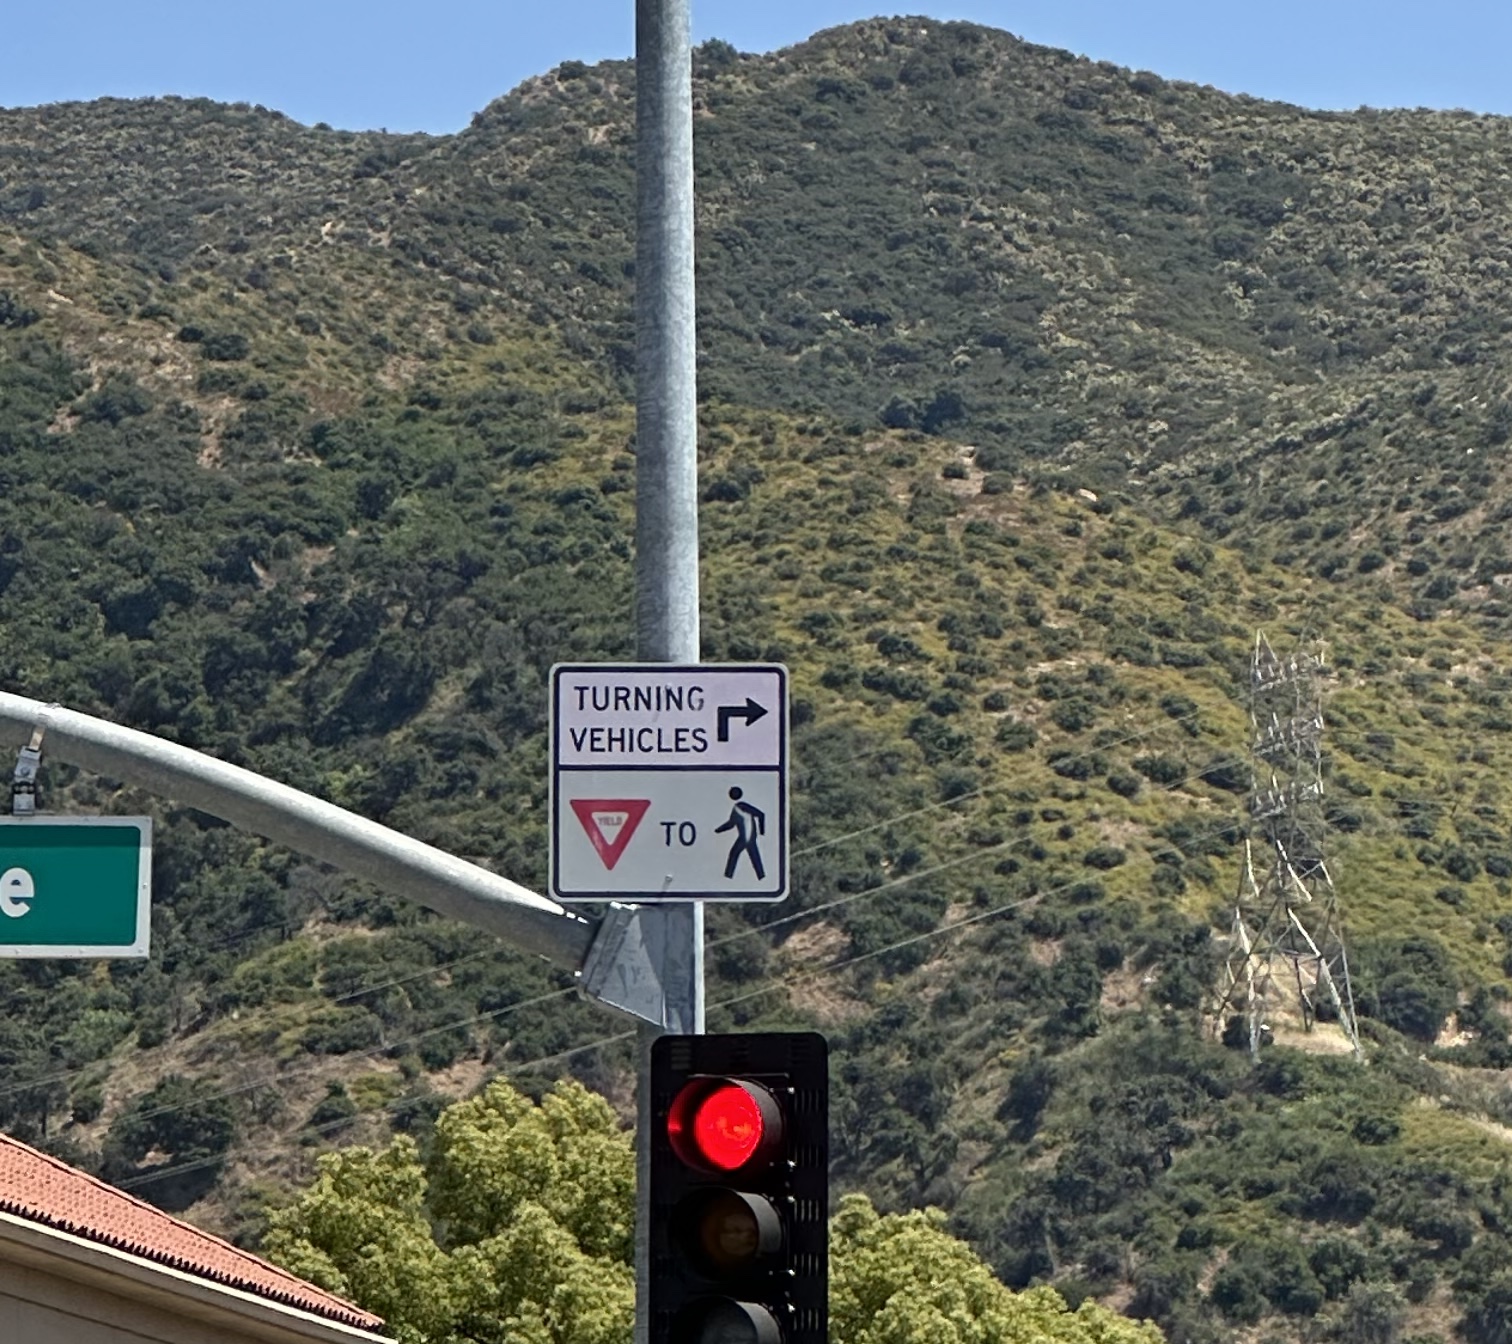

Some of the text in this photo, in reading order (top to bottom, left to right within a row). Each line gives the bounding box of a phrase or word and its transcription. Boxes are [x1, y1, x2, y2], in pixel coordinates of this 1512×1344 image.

[574, 686, 704, 712] TURNING
[569, 727, 708, 753] VEHICLES
[597, 816, 623, 827] YIELD
[660, 821, 697, 847] TO
